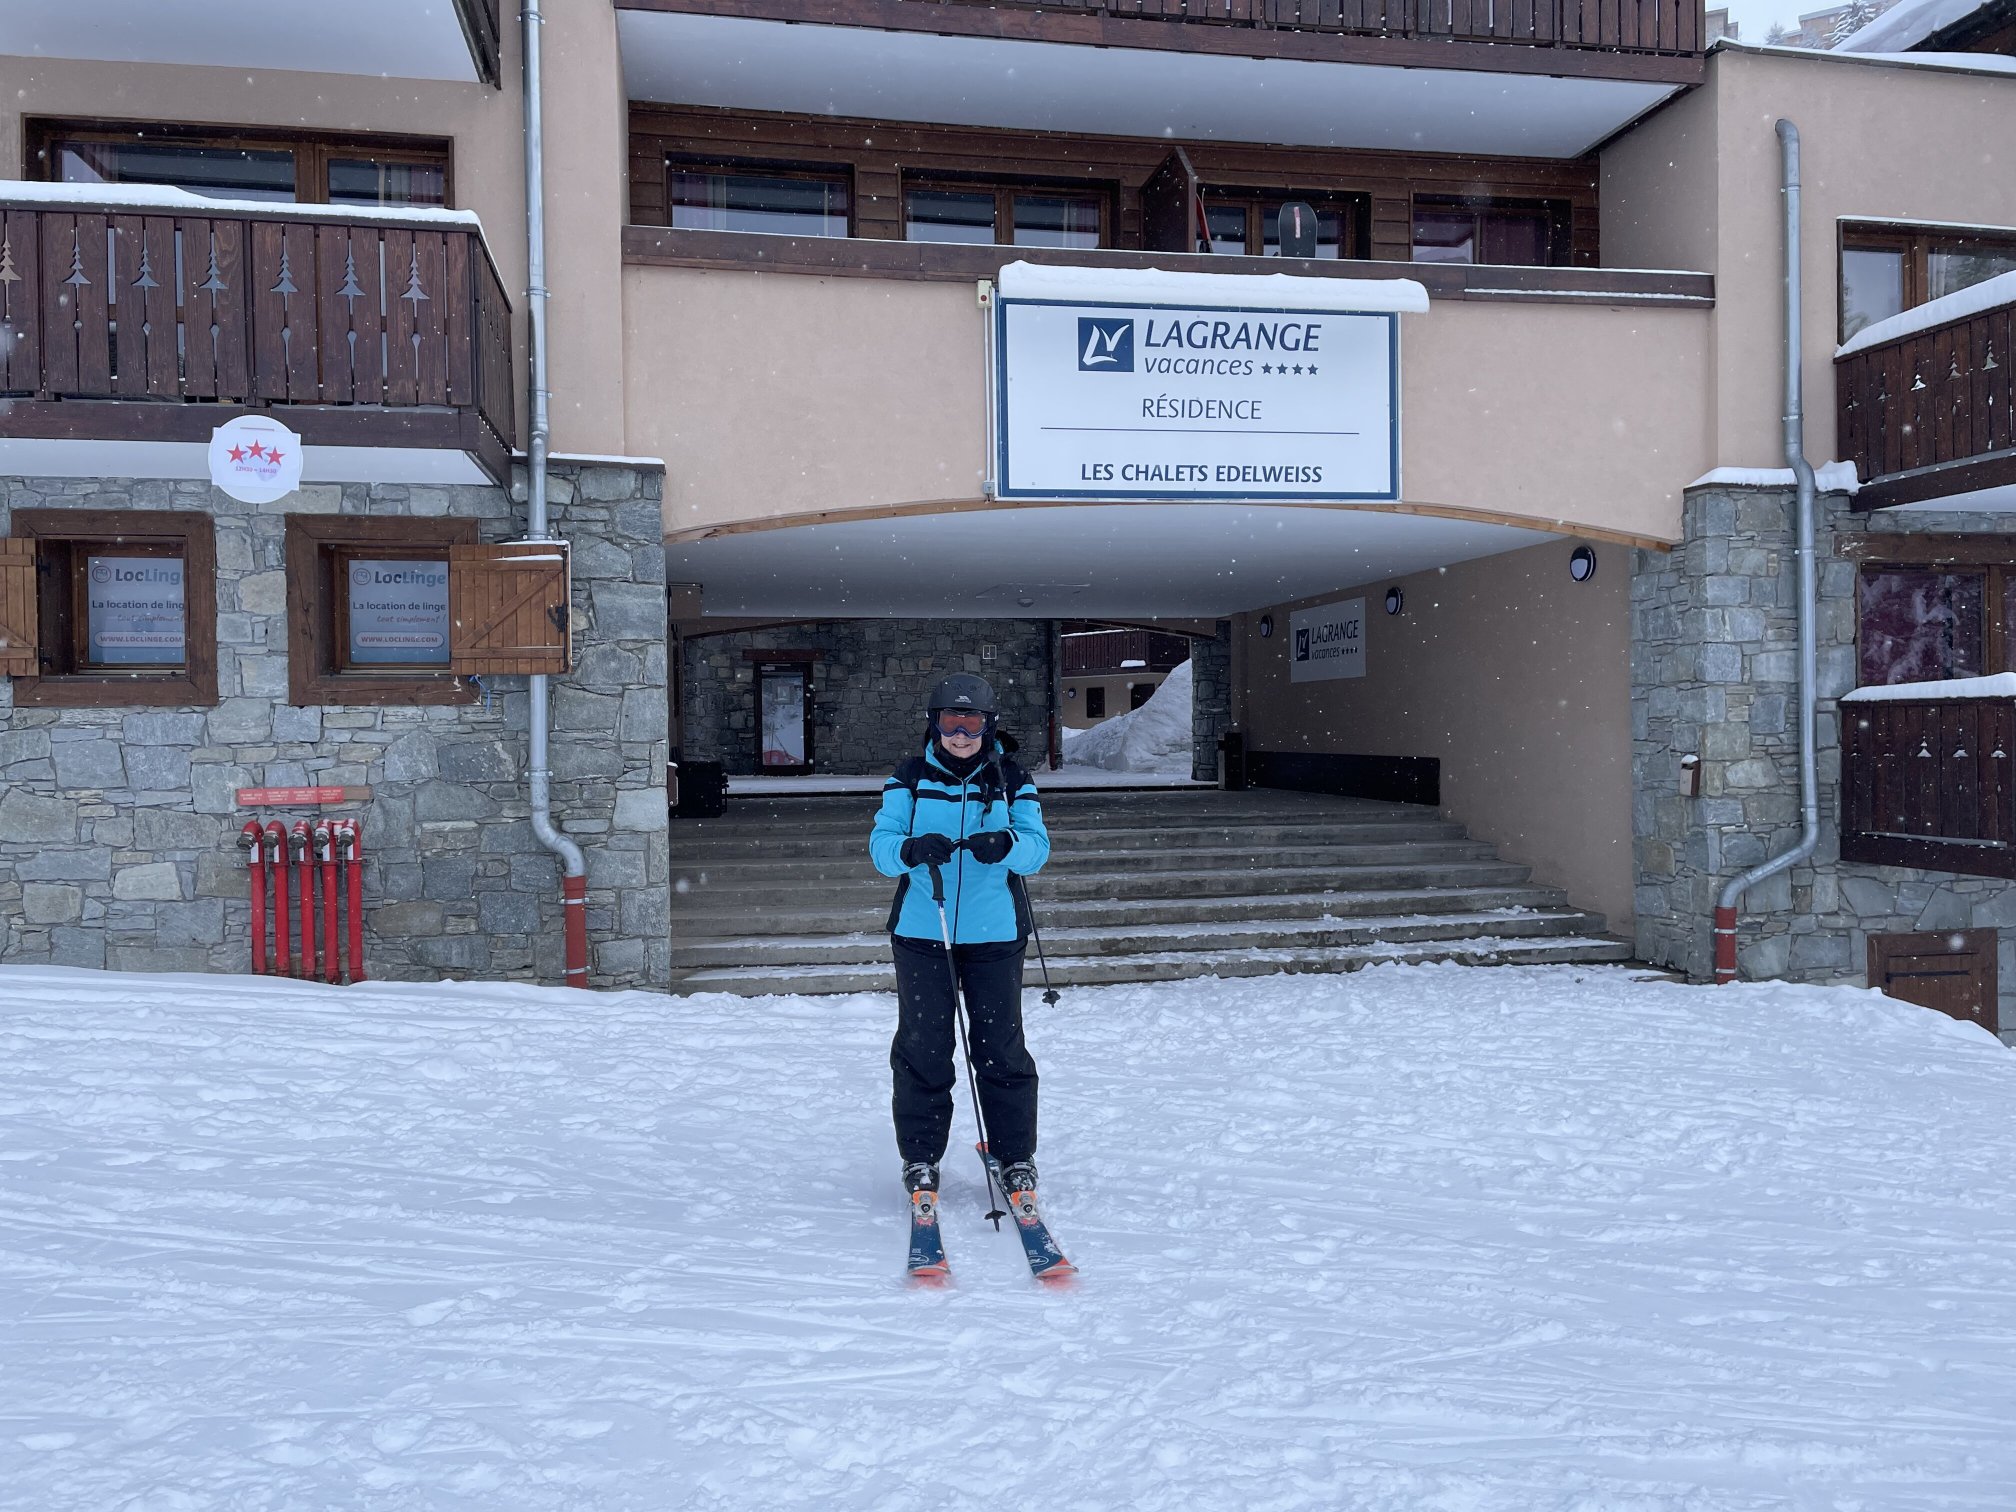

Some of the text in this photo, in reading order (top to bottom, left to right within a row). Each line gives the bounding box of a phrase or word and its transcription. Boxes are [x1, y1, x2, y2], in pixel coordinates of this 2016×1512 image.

[1144, 318, 1322, 352] LAGRANGE
[1144, 355, 1254, 376] vacances
[1142, 393, 1263, 420] RÉSIDENCE
[1081, 462, 1323, 483] LES CHALETS EDELWEISS
[115, 568, 184, 585] LocLing
[92, 600, 104, 609] La
[106, 600, 148, 609] location
[150, 601, 164, 609] de
[353, 602, 447, 613] La location de linge
[361, 635, 438, 643] WWW.LOCLINGE.COM
[1311, 619, 1359, 645] LAGRANGE
[1311, 646, 1341, 660] vacances
